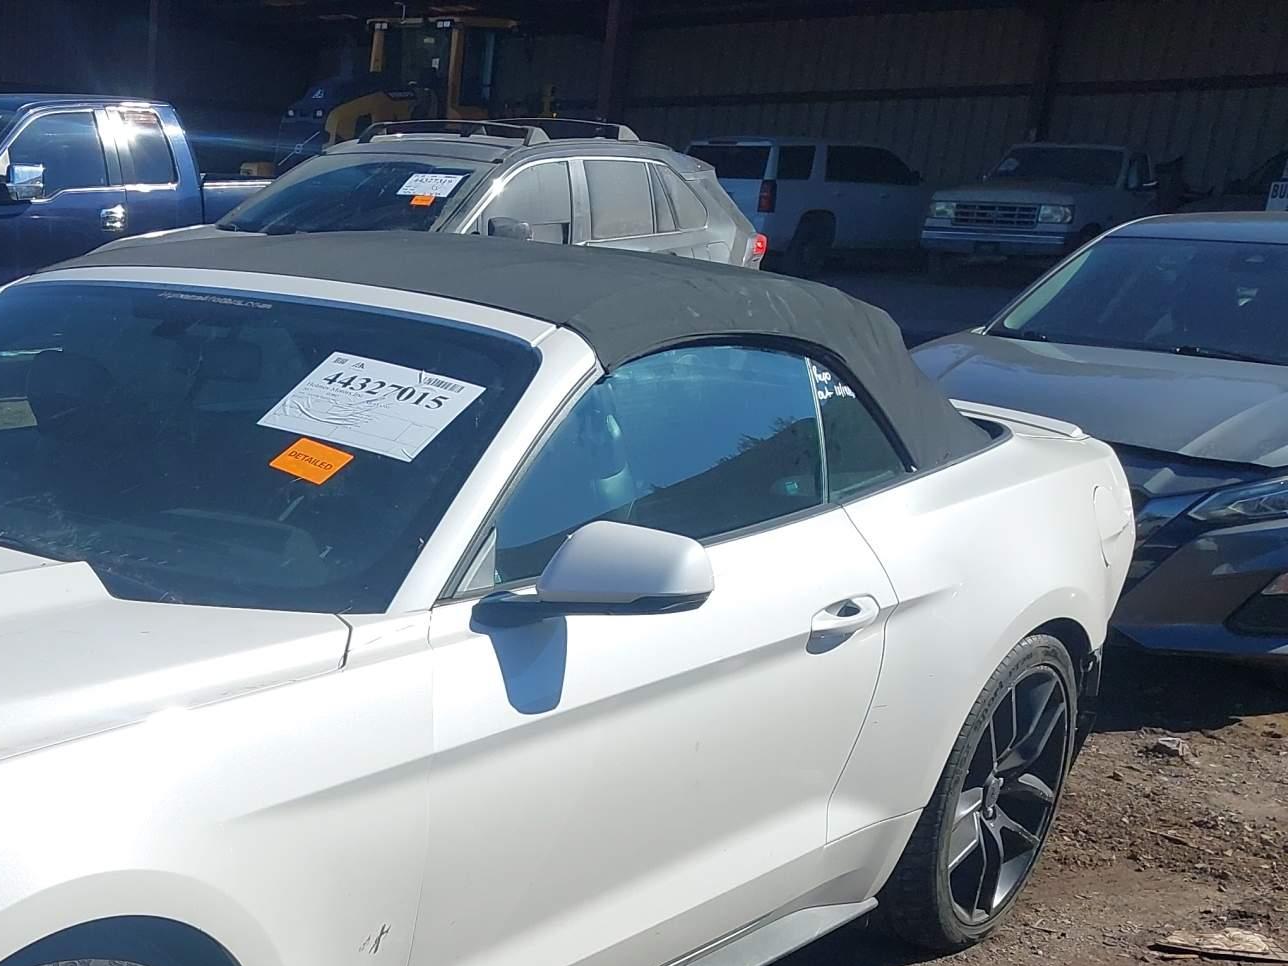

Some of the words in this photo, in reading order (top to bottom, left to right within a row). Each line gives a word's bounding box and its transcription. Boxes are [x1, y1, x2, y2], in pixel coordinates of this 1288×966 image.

[1271, 183, 1288, 199] BU
[322, 370, 450, 410] 44327015
[286, 449, 334, 472] DETAILED
